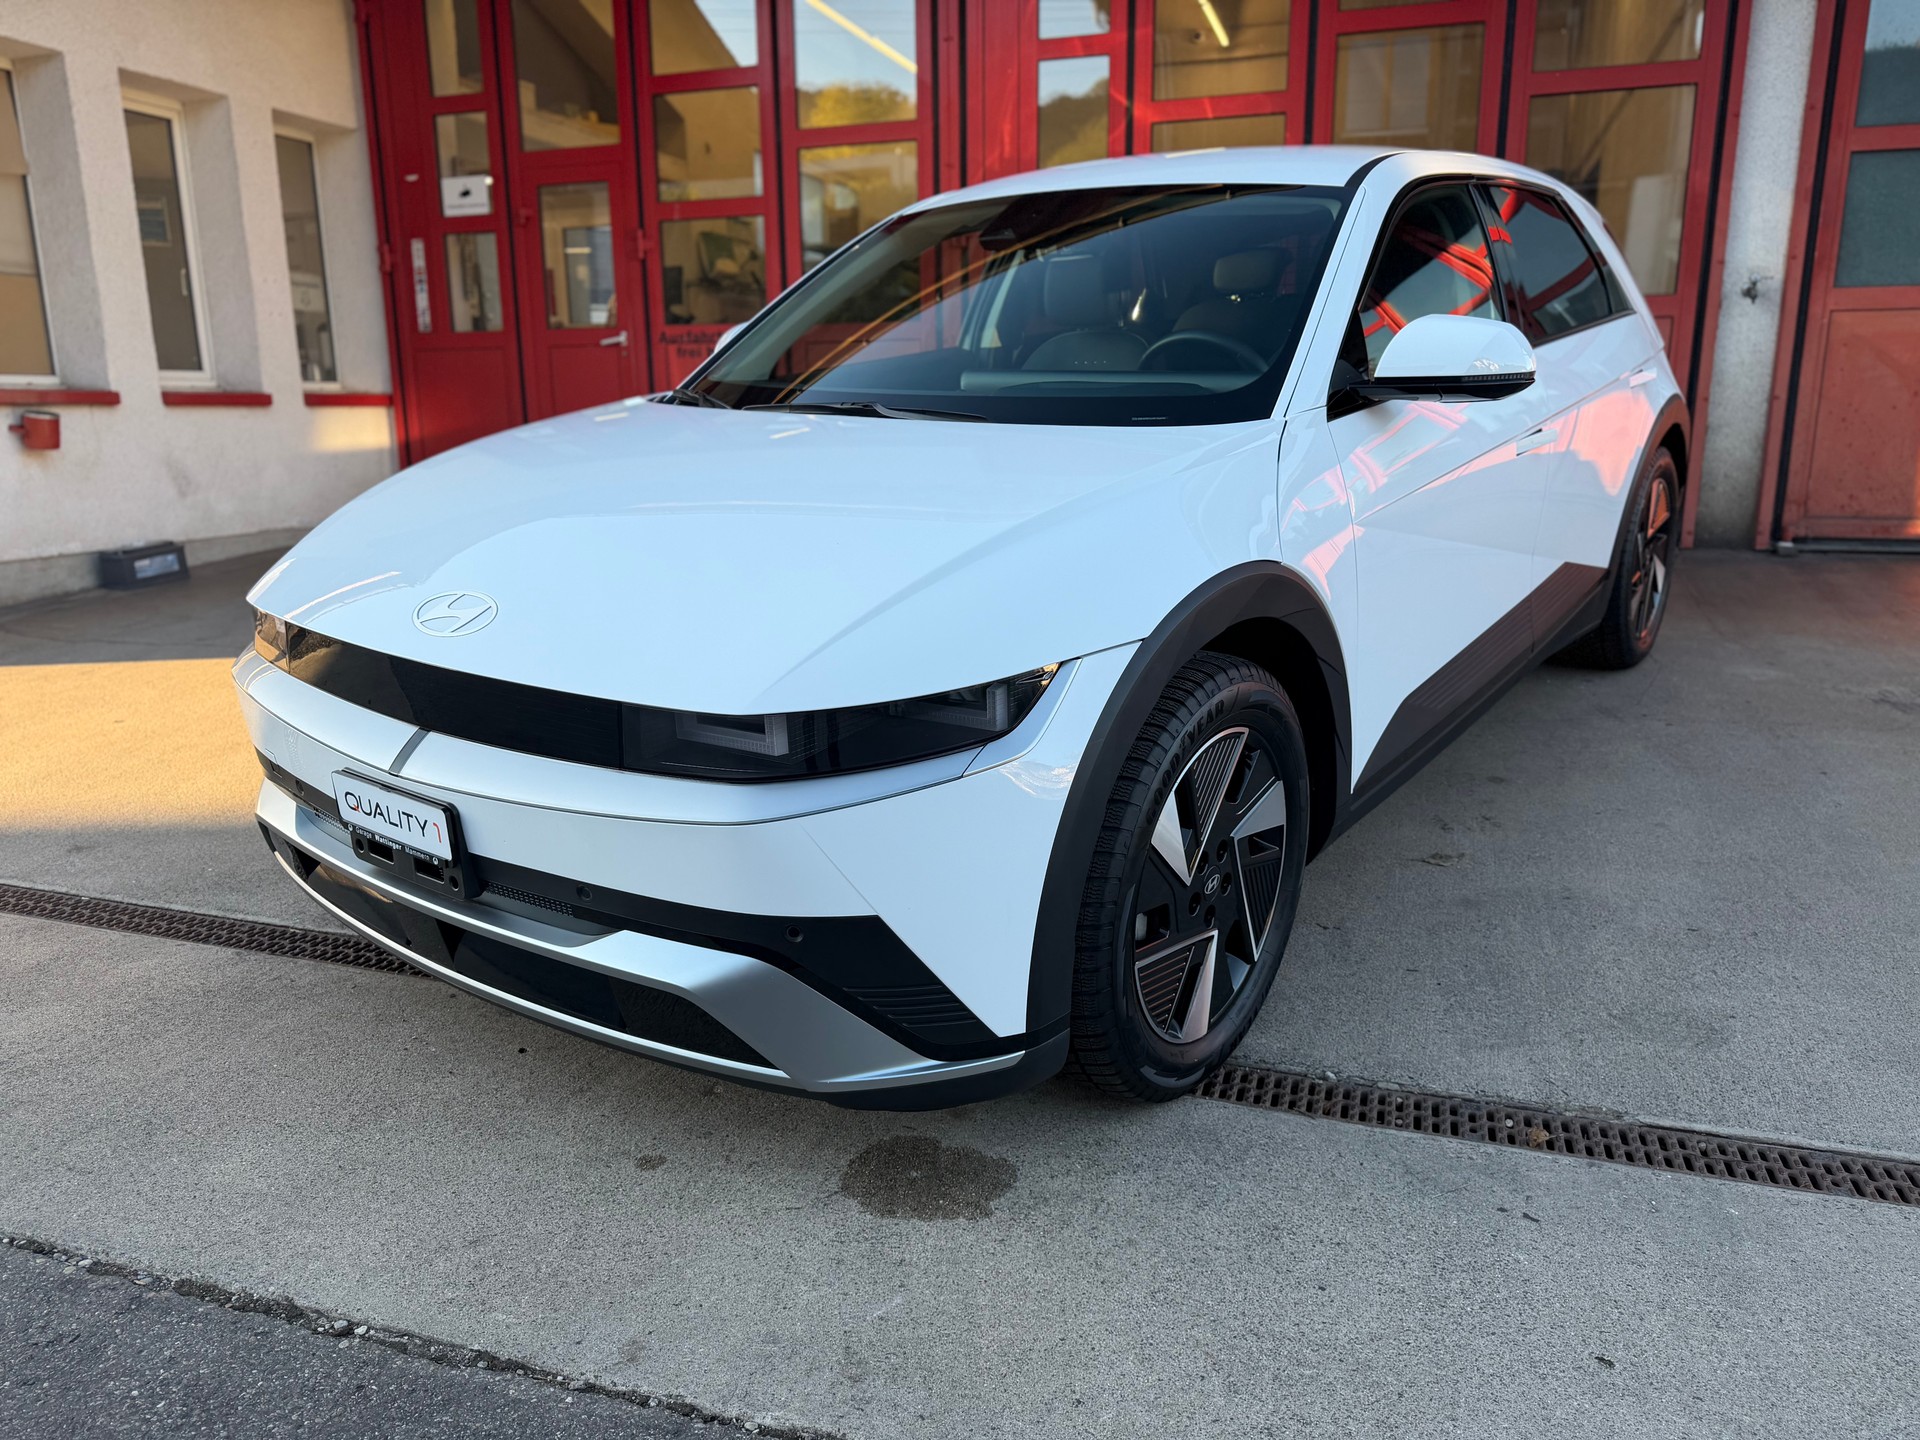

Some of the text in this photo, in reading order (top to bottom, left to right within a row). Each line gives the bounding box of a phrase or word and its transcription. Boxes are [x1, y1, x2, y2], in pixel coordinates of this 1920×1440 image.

[1145, 699, 1225, 826] GOODYEAR
[344, 791, 442, 844] QUALITY 1
